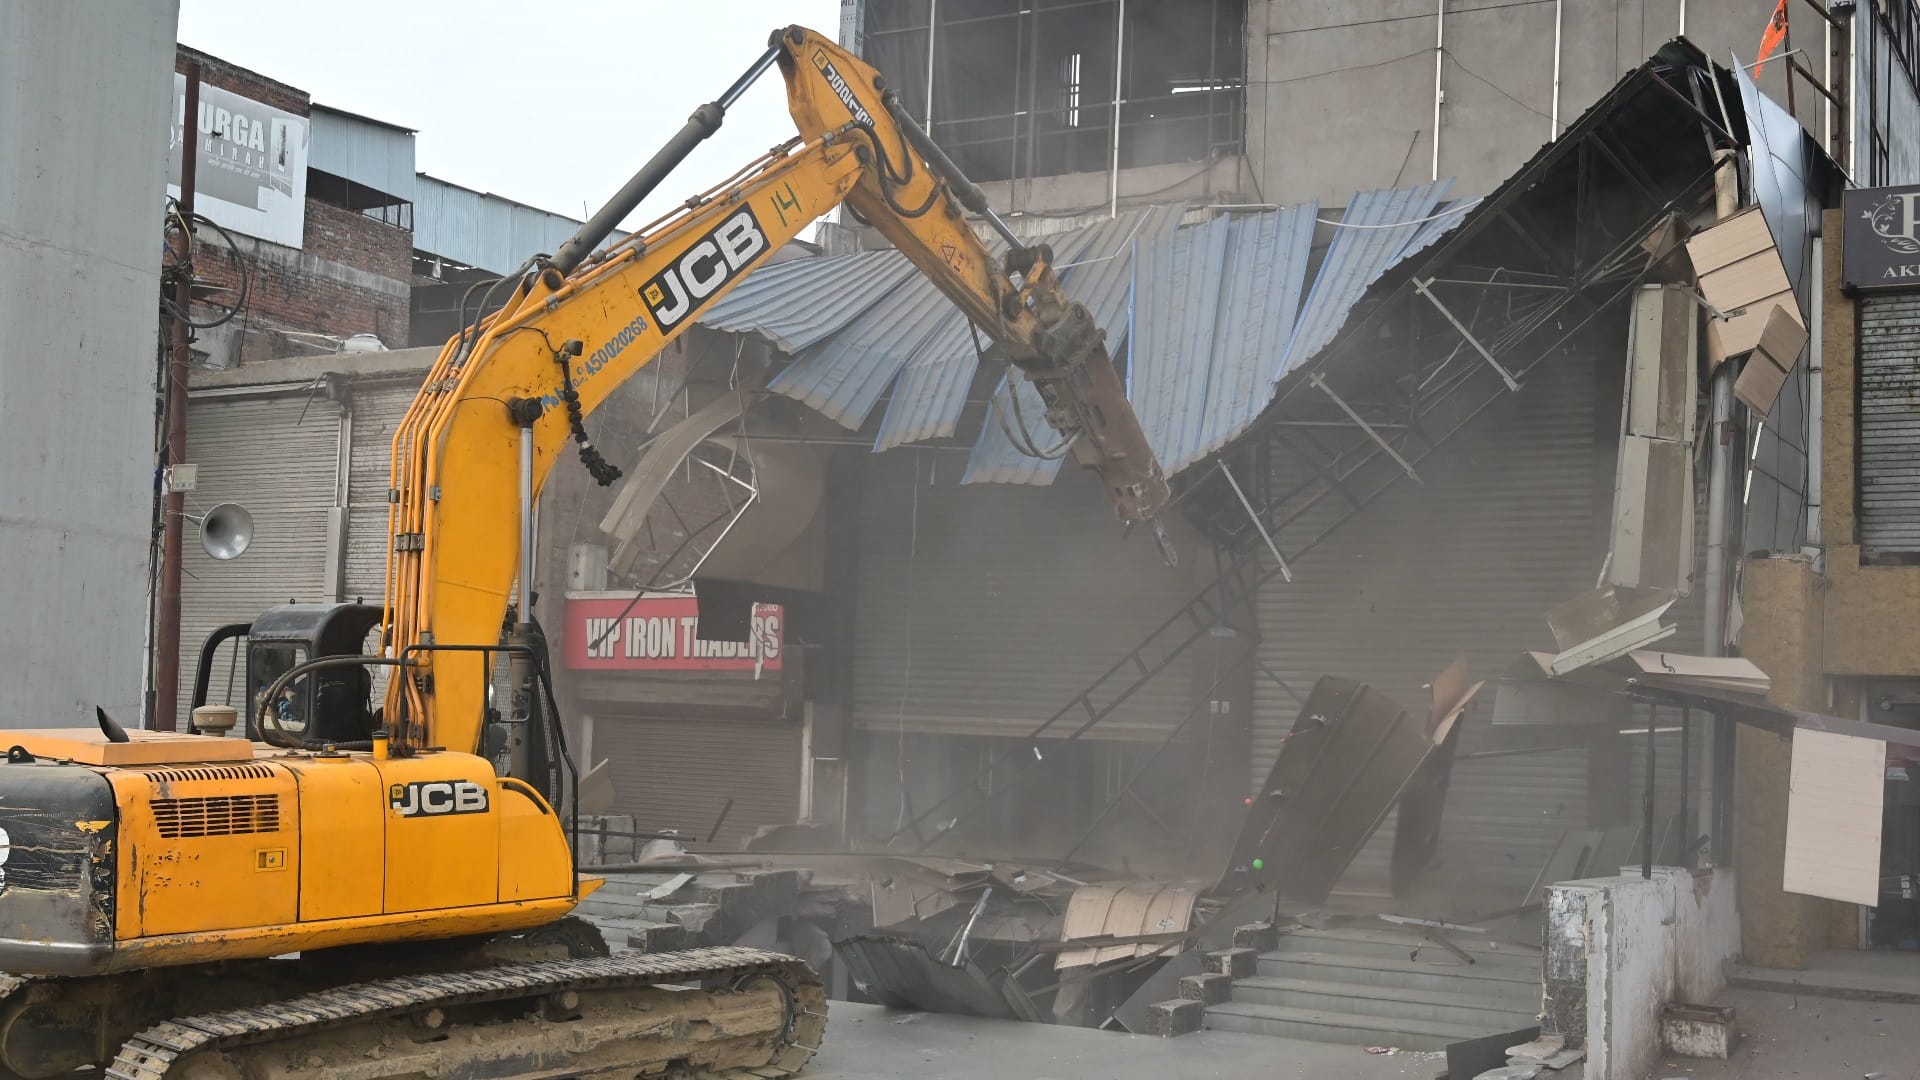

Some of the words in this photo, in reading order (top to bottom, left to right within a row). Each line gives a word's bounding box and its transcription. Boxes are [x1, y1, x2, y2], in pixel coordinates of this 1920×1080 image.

[178, 129, 265, 169] AMIRAH
[770, 181, 802, 227] 14
[655, 211, 764, 326] JCB
[1883, 265, 1920, 278] AK
[585, 618, 621, 658] VIP
[625, 616, 676, 658] IRON
[392, 782, 487, 815] JCB
